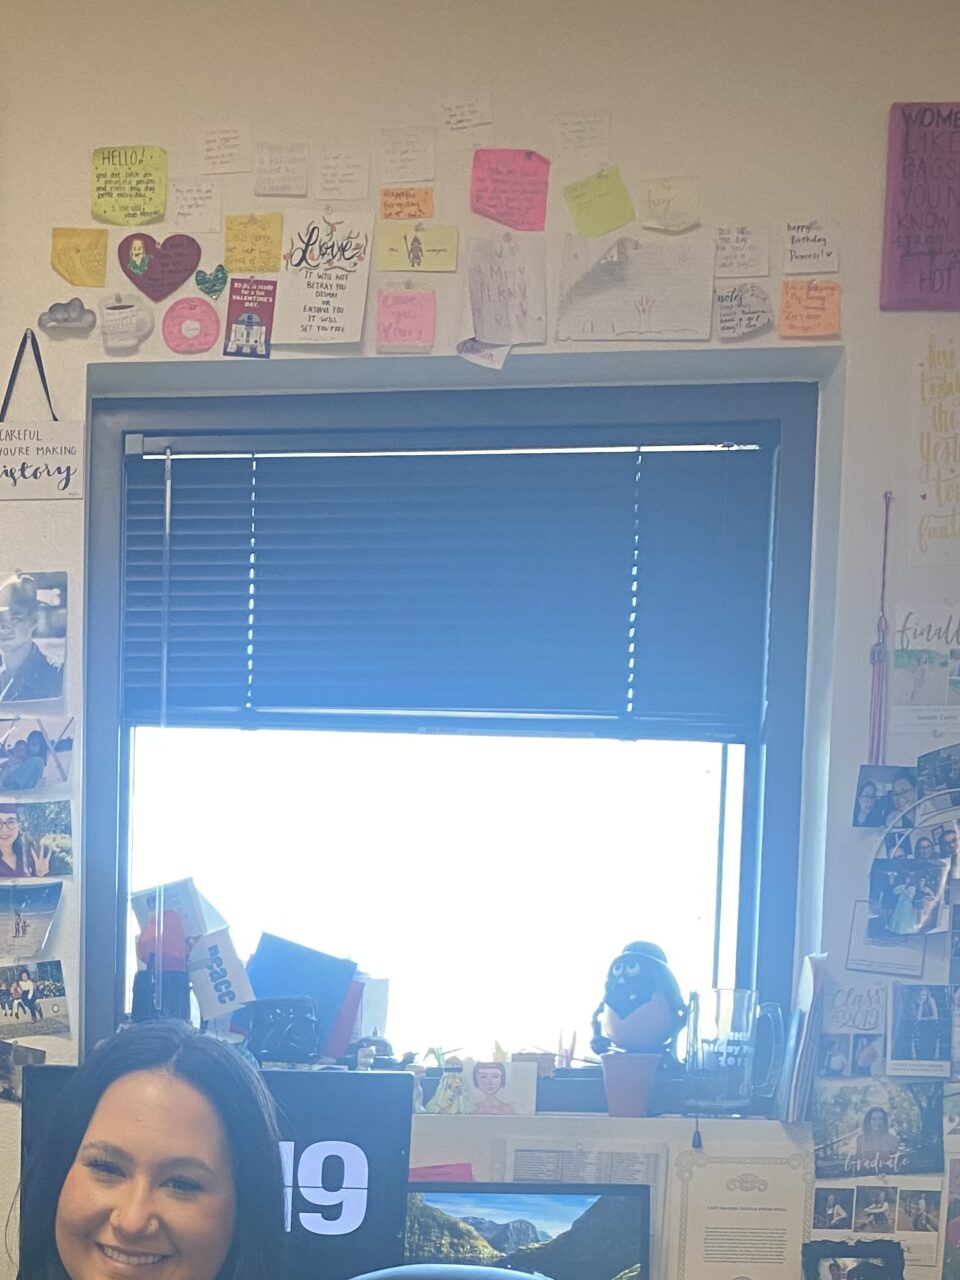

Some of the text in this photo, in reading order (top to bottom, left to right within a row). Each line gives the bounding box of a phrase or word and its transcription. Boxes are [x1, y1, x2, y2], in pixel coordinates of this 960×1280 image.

[102, 148, 145, 166] HELLO!
[290, 226, 360, 268] Love
[307, 283, 333, 291] BETRAY
[0, 429, 42, 441] CAREFUL
[36, 446, 77, 456] MAKING
[844, 1152, 910, 1173] Graduate
